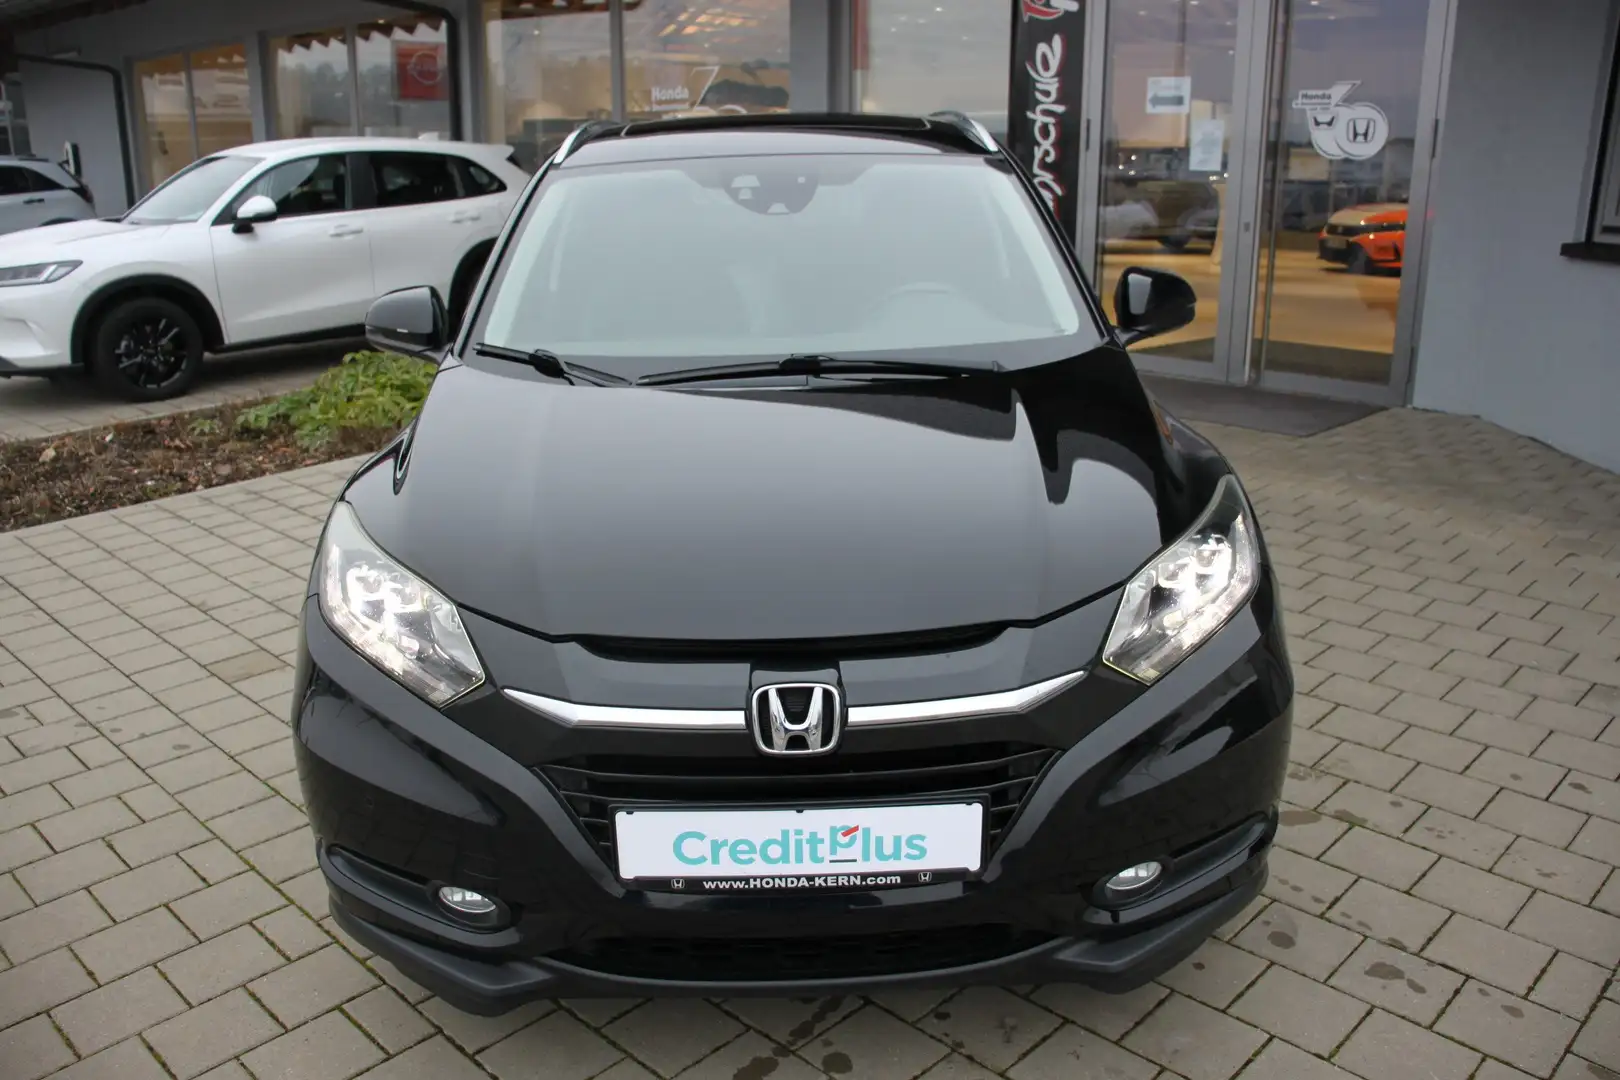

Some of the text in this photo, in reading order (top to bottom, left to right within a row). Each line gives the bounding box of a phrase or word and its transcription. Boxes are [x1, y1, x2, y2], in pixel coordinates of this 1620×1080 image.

[651, 86, 689, 101] Honda
[1301, 92, 1332, 100] Honda
[672, 825, 928, 866] CreditPlus
[703, 875, 901, 889] www.HONDA-KERN.com
